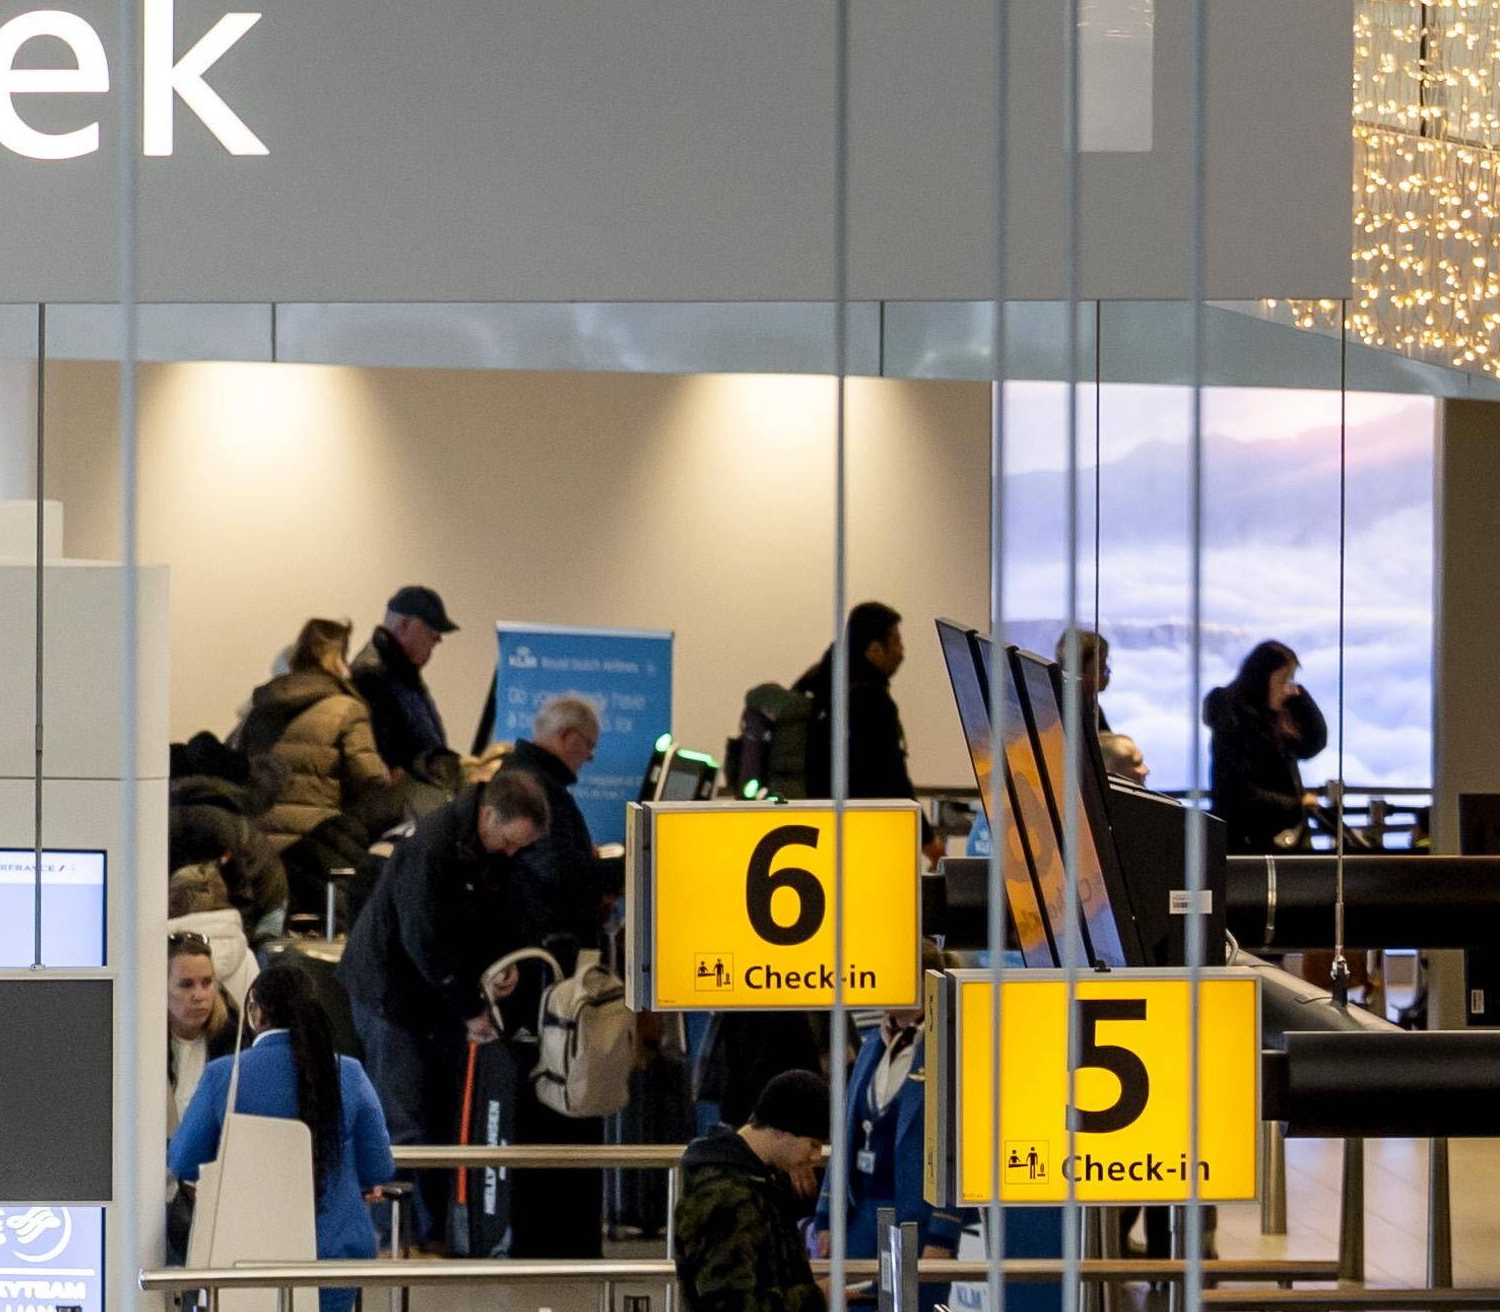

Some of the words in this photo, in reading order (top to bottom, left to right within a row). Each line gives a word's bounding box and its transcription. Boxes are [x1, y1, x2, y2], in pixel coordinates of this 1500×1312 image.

[744, 822, 827, 948] 6
[1065, 999, 1149, 1135] 5
[1060, 1152, 1211, 1184] Check-in
